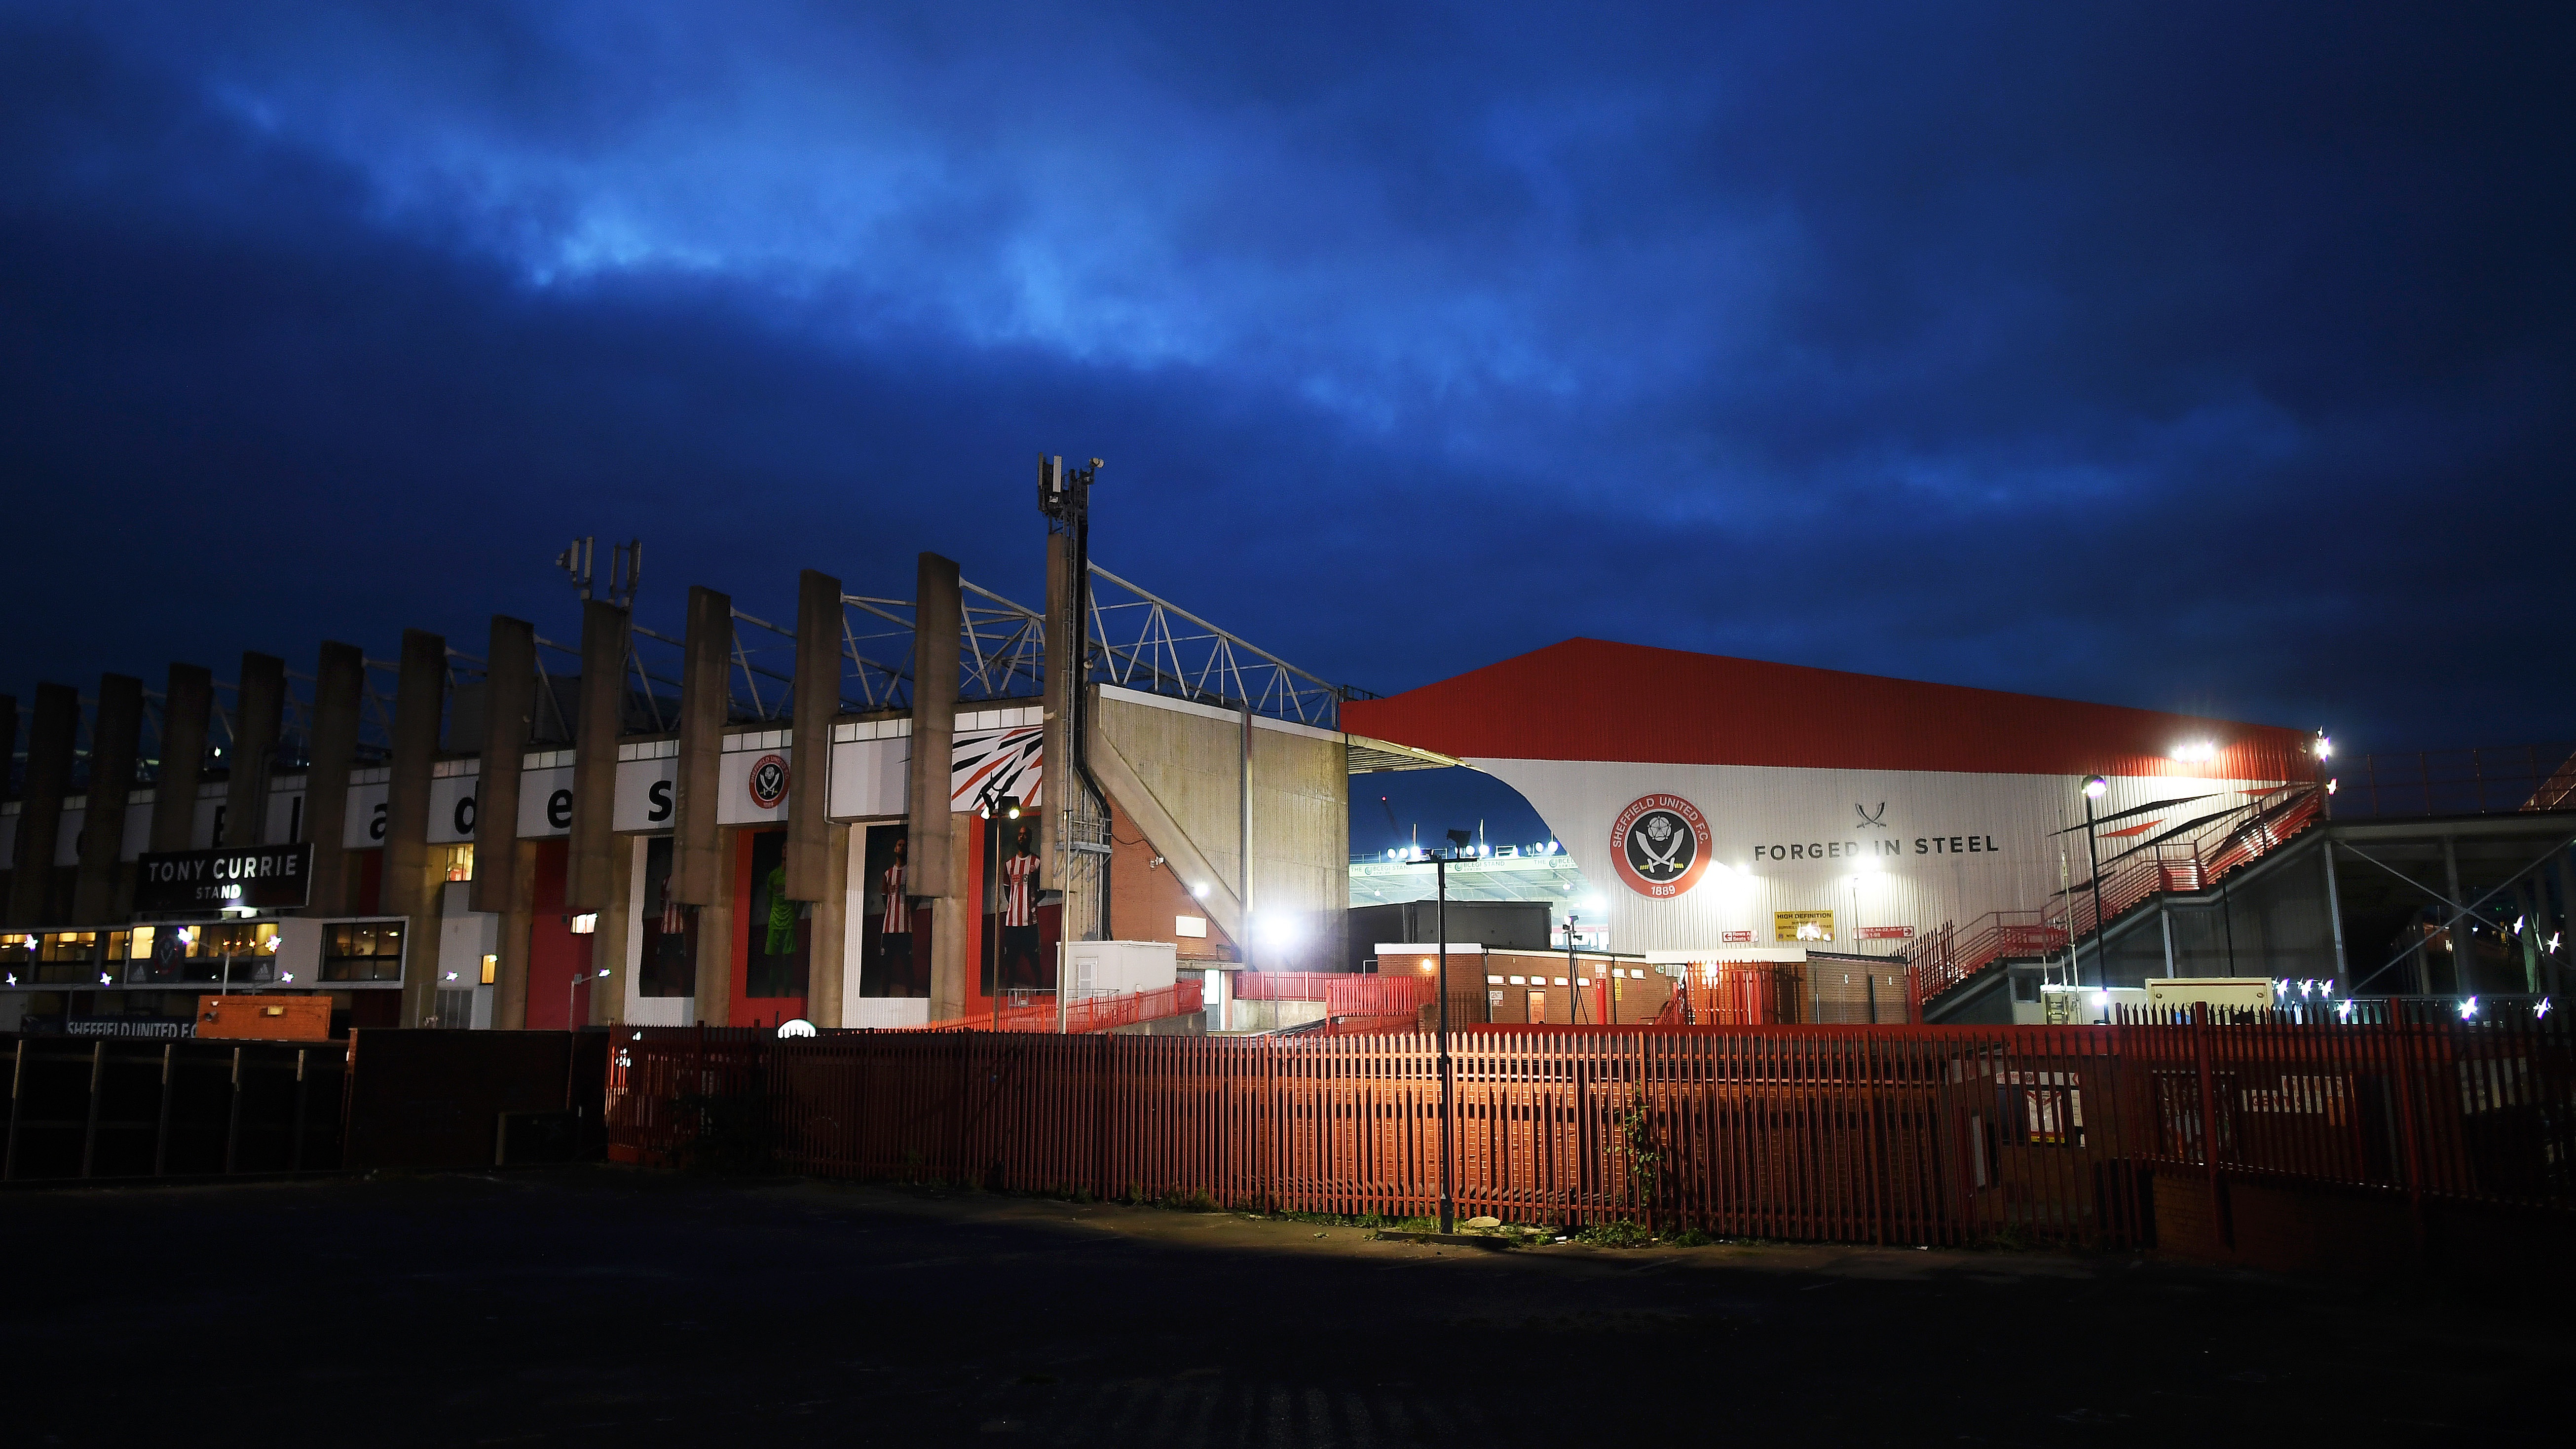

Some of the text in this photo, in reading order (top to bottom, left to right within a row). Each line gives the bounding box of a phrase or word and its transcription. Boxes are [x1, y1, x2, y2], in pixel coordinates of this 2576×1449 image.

[1613, 798, 1655, 848] SHEFFIELD
[1659, 797, 1698, 821] UNITED
[1754, 835, 1999, 861] FORGED IN STEEL
[149, 855, 298, 882] TONY CURRIE
[196, 883, 243, 899] STAND
[1651, 885, 1676, 895] 1889
[132, 1023, 178, 1037] UNITED
